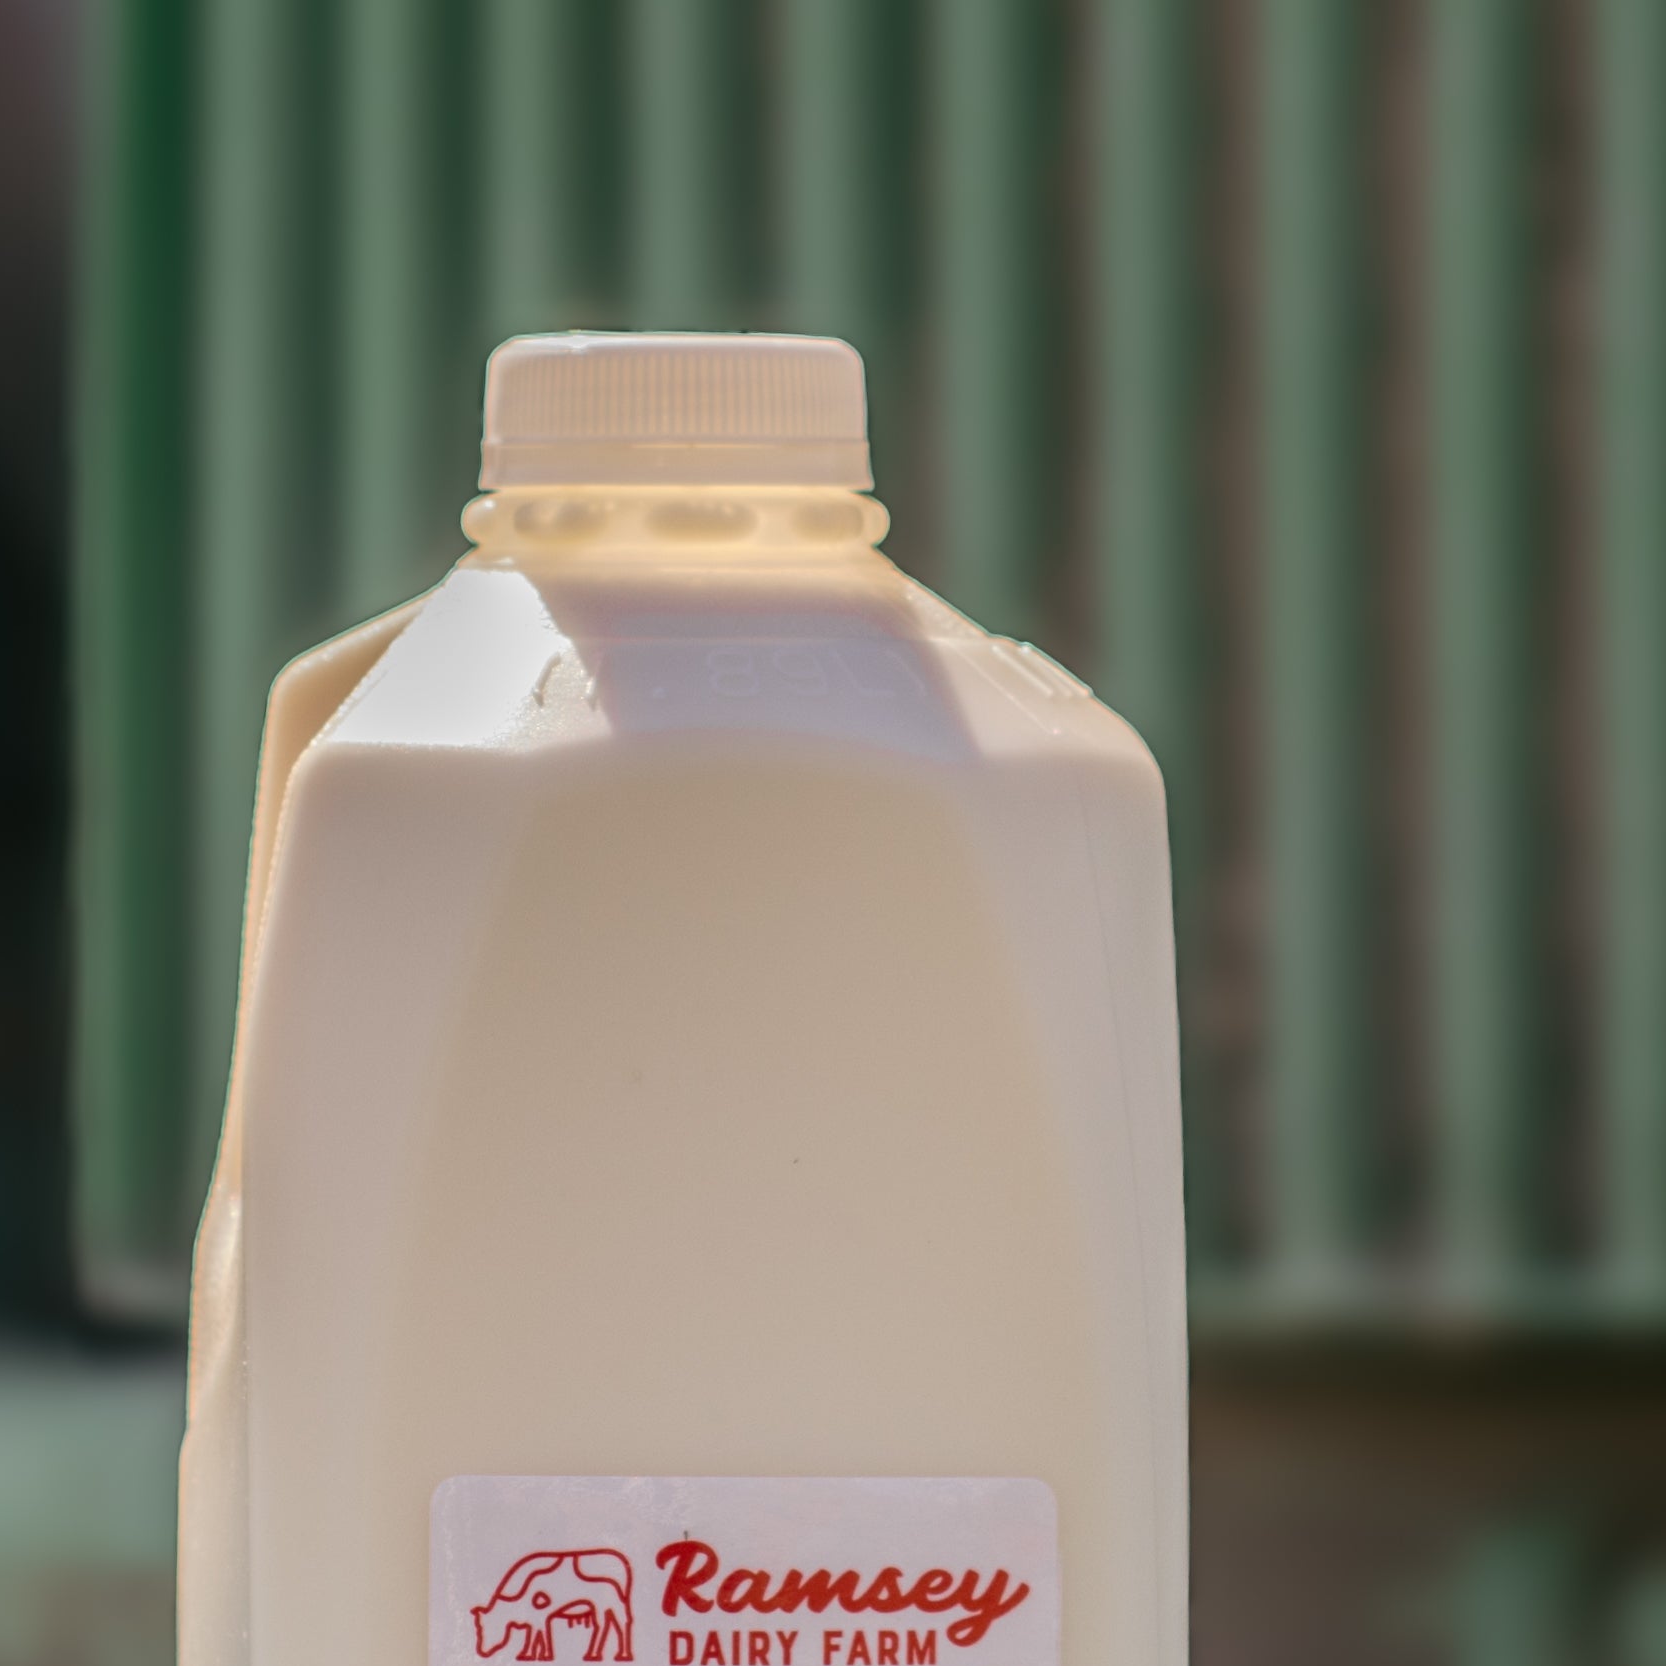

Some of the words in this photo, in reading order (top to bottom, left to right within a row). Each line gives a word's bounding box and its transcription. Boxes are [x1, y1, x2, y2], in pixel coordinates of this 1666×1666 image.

[654, 1540, 1031, 1649] Ramsey
[668, 1629, 800, 1666] DAIRY
[822, 1628, 938, 1666] FARM
